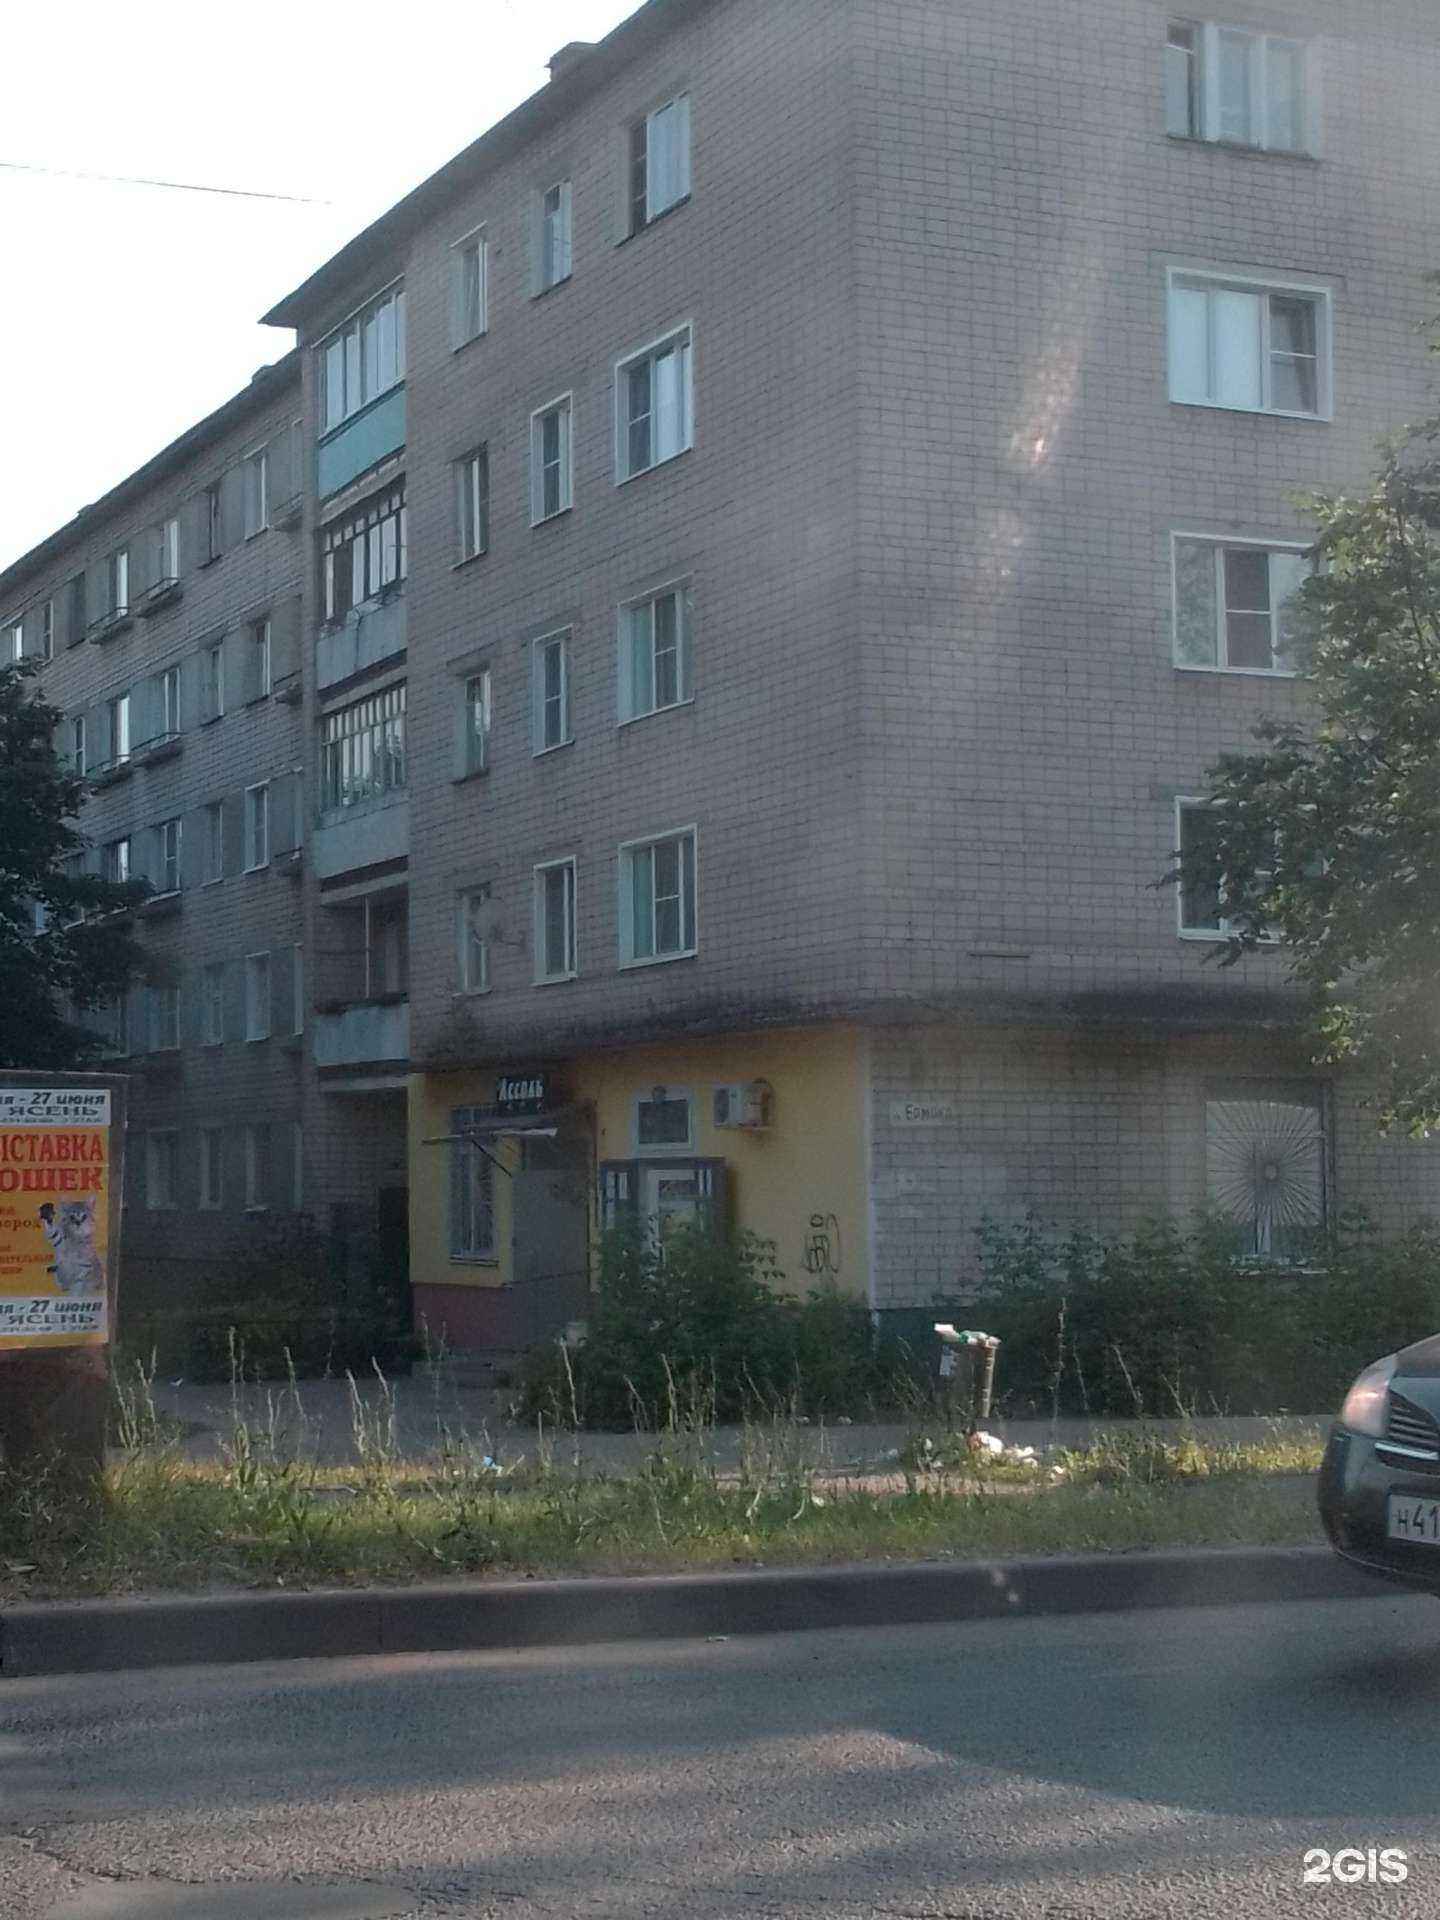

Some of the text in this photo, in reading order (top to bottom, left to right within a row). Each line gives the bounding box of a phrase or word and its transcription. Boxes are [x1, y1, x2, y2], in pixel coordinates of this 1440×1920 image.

[31, 1092, 52, 1105] 27
[56, 1095, 106, 1105] июня
[9, 1106, 99, 1116] ЯСЕНЬ
[30, 1300, 50, 1313] 27
[54, 1302, 103, 1312] июня
[7, 1314, 95, 1325] ЯСЕНЬ
